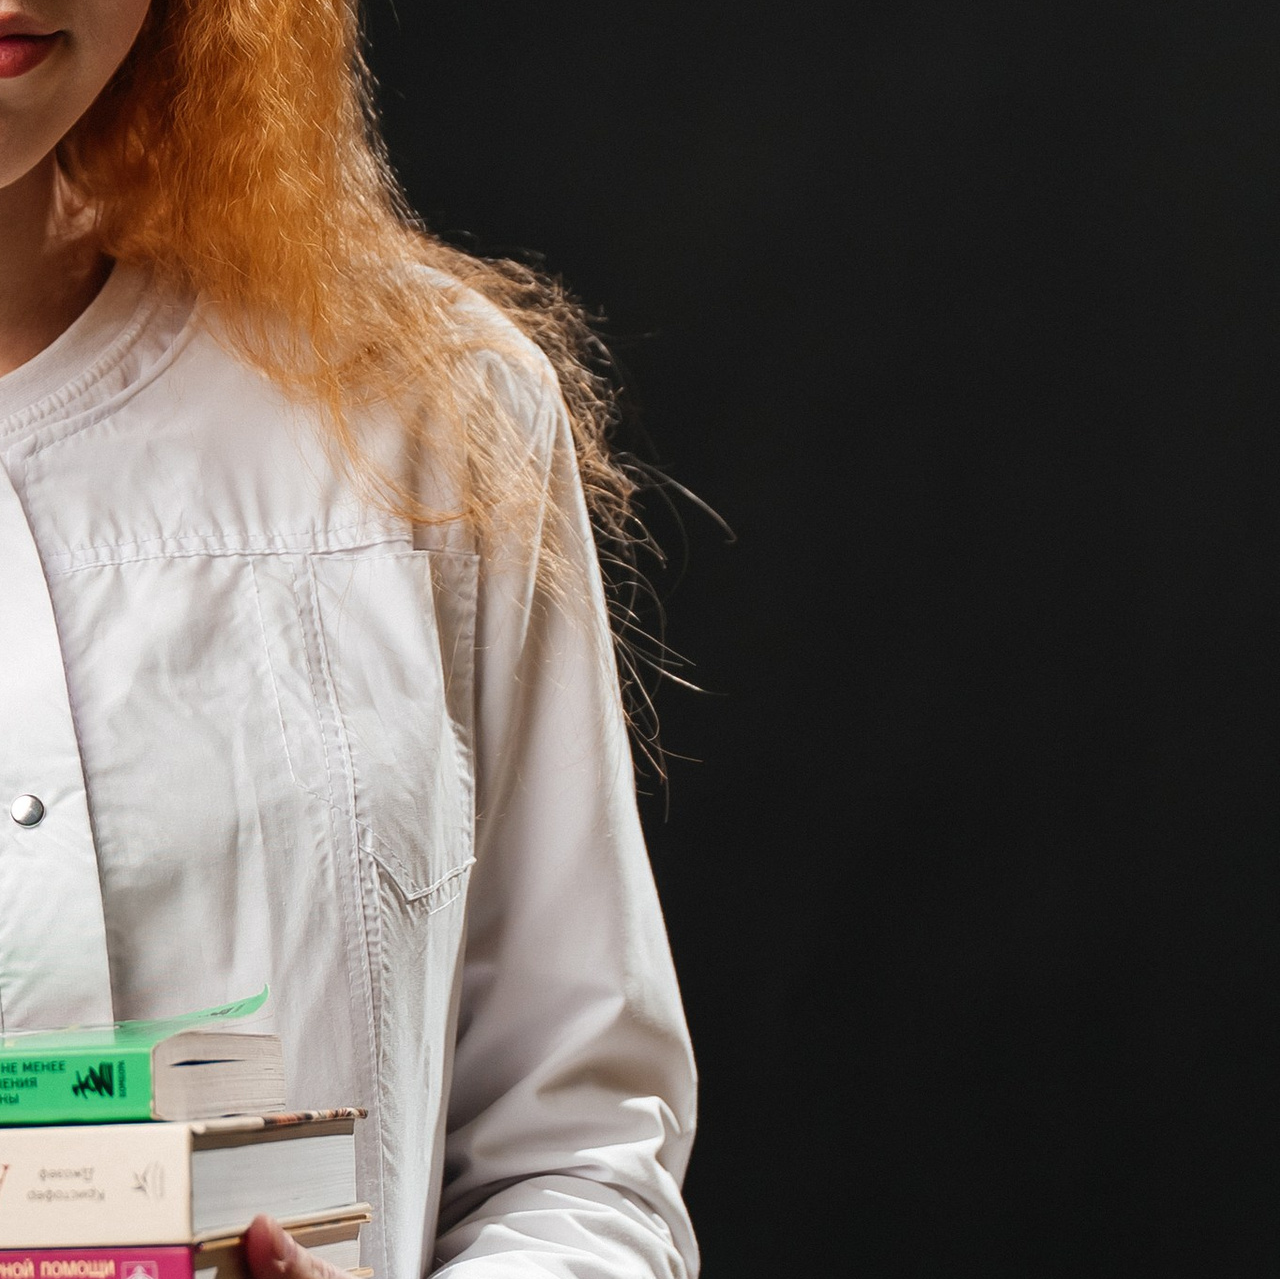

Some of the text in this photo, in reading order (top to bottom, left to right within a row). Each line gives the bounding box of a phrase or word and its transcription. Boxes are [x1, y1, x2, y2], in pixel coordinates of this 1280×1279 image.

[1, 1062, 18, 1073] НЕ
[22, 1060, 66, 1072] МЕНЕЕ
[40, 1259, 116, 1279] ПОМОЩИ
